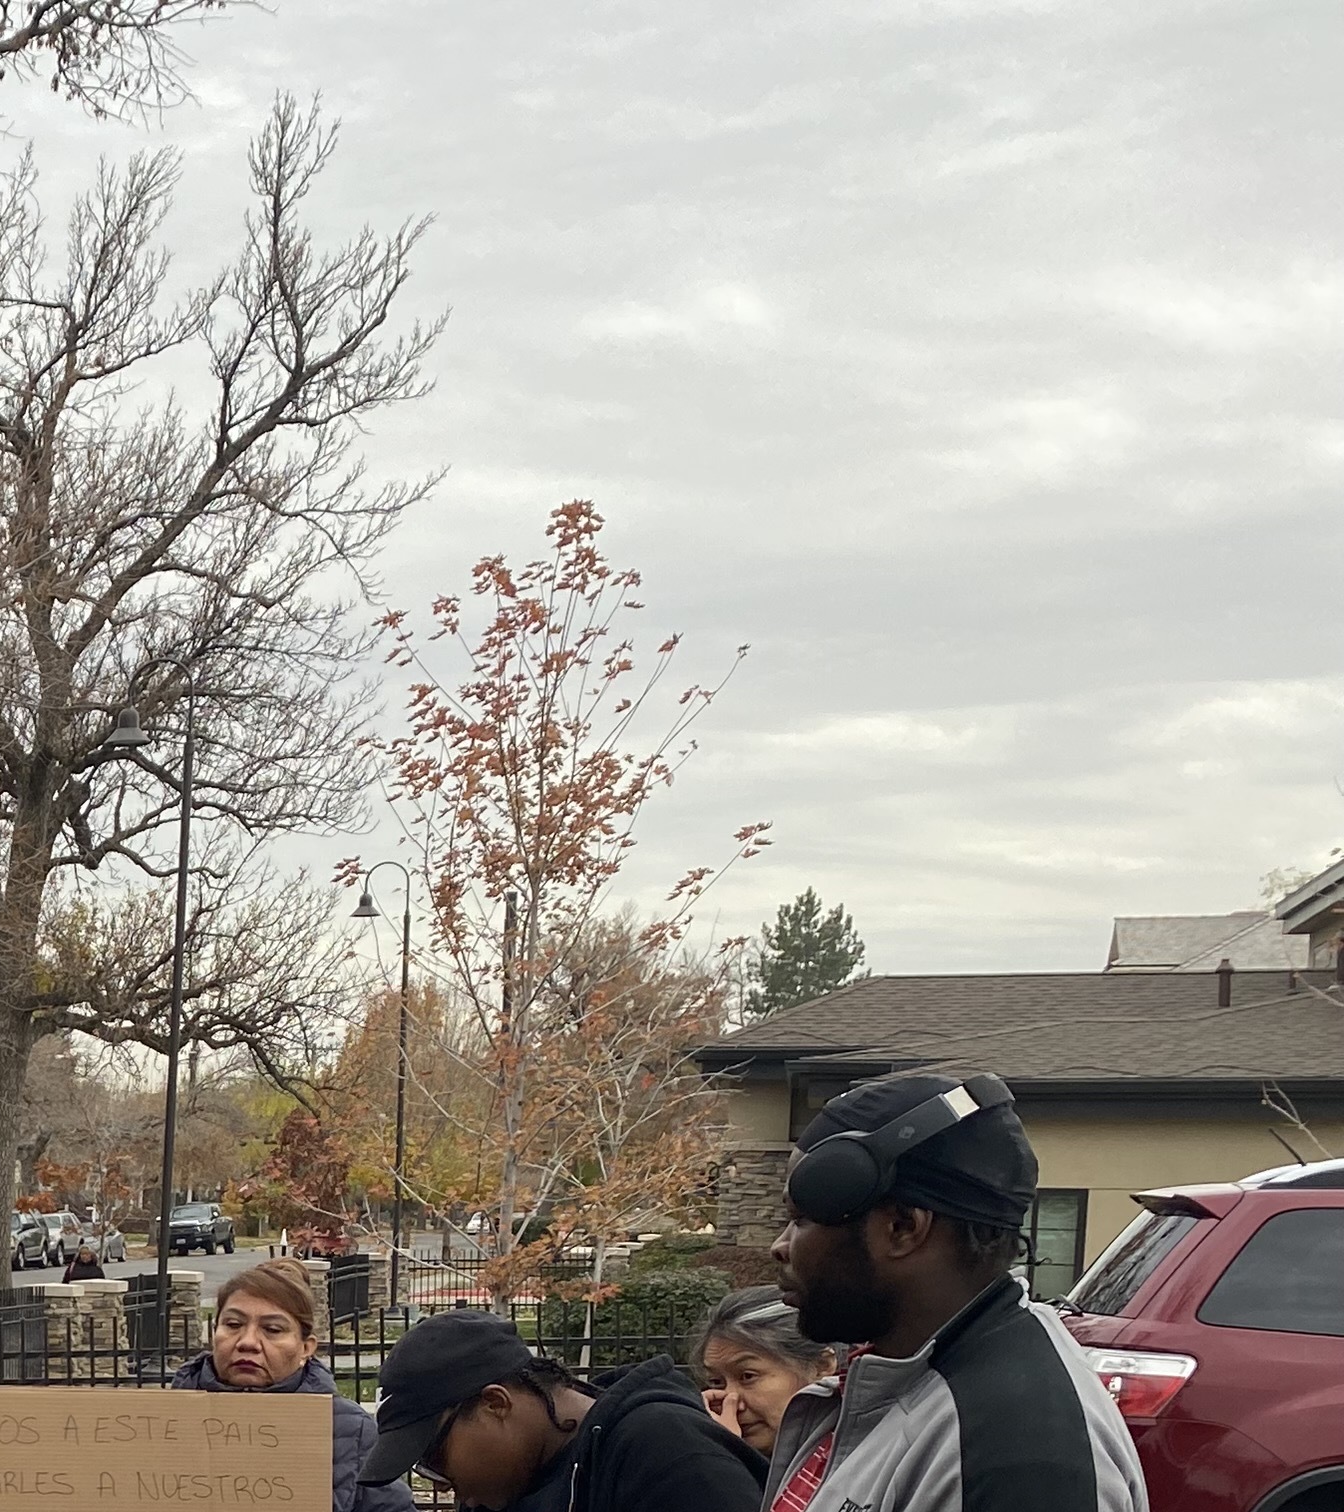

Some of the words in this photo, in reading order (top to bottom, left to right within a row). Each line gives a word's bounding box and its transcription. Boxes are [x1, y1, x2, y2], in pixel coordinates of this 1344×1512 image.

[63, 1414, 80, 1446] A
[94, 1413, 179, 1443] ESTE
[202, 1417, 280, 1450] PAIS
[96, 1471, 117, 1498] A
[136, 1471, 295, 1504] NUESTROS
